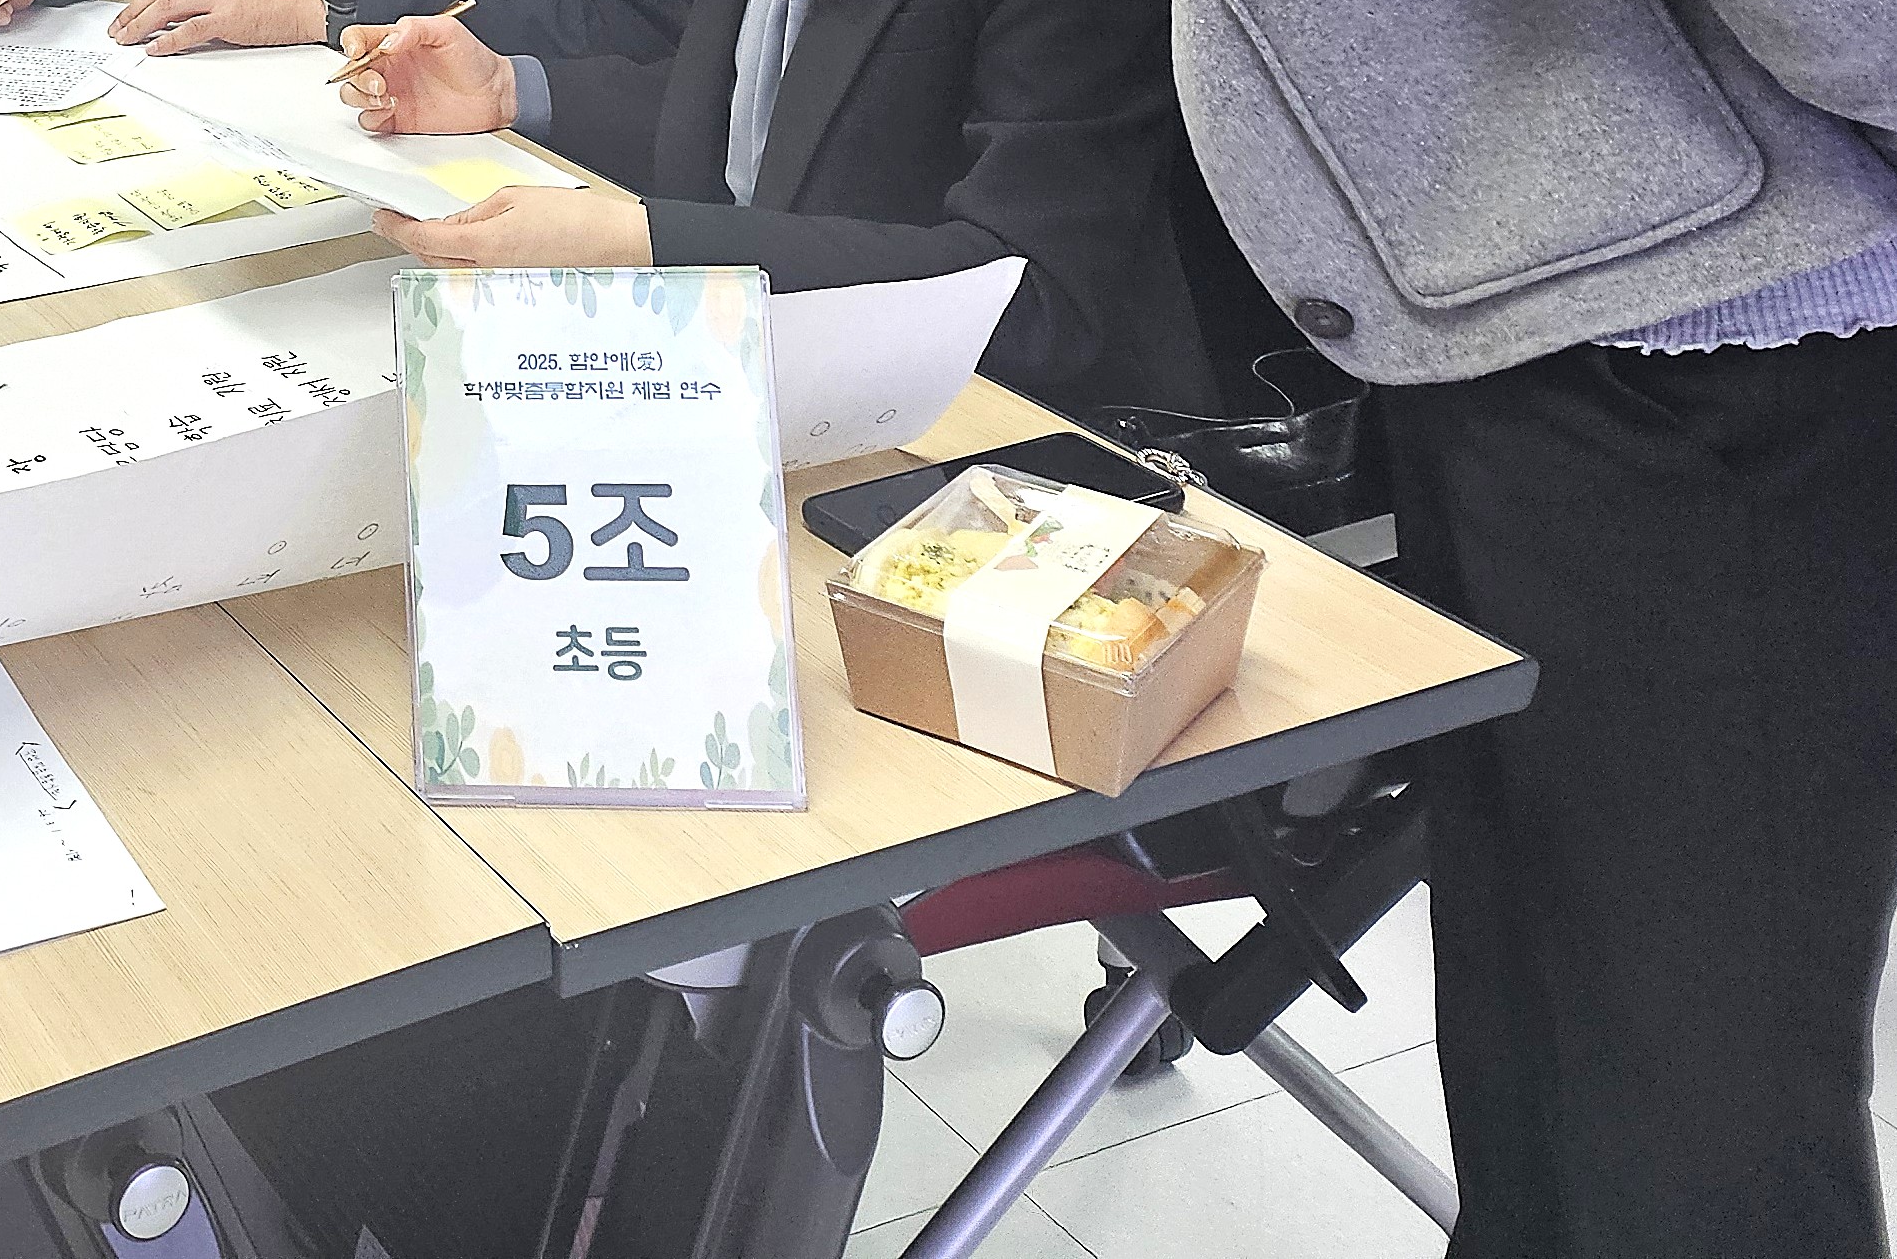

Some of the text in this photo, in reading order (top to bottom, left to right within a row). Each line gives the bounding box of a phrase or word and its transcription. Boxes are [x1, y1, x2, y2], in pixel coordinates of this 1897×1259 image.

[517, 351, 664, 372] 2025. 함안애(愛)
[202, 371, 246, 398] 지원
[260, 351, 352, 407] 정서 지원
[463, 380, 722, 402] 학생맞춤통합지원 체험 연수
[168, 413, 213, 443] 학습
[499, 483, 691, 582] 5조
[552, 623, 648, 681] 초등
